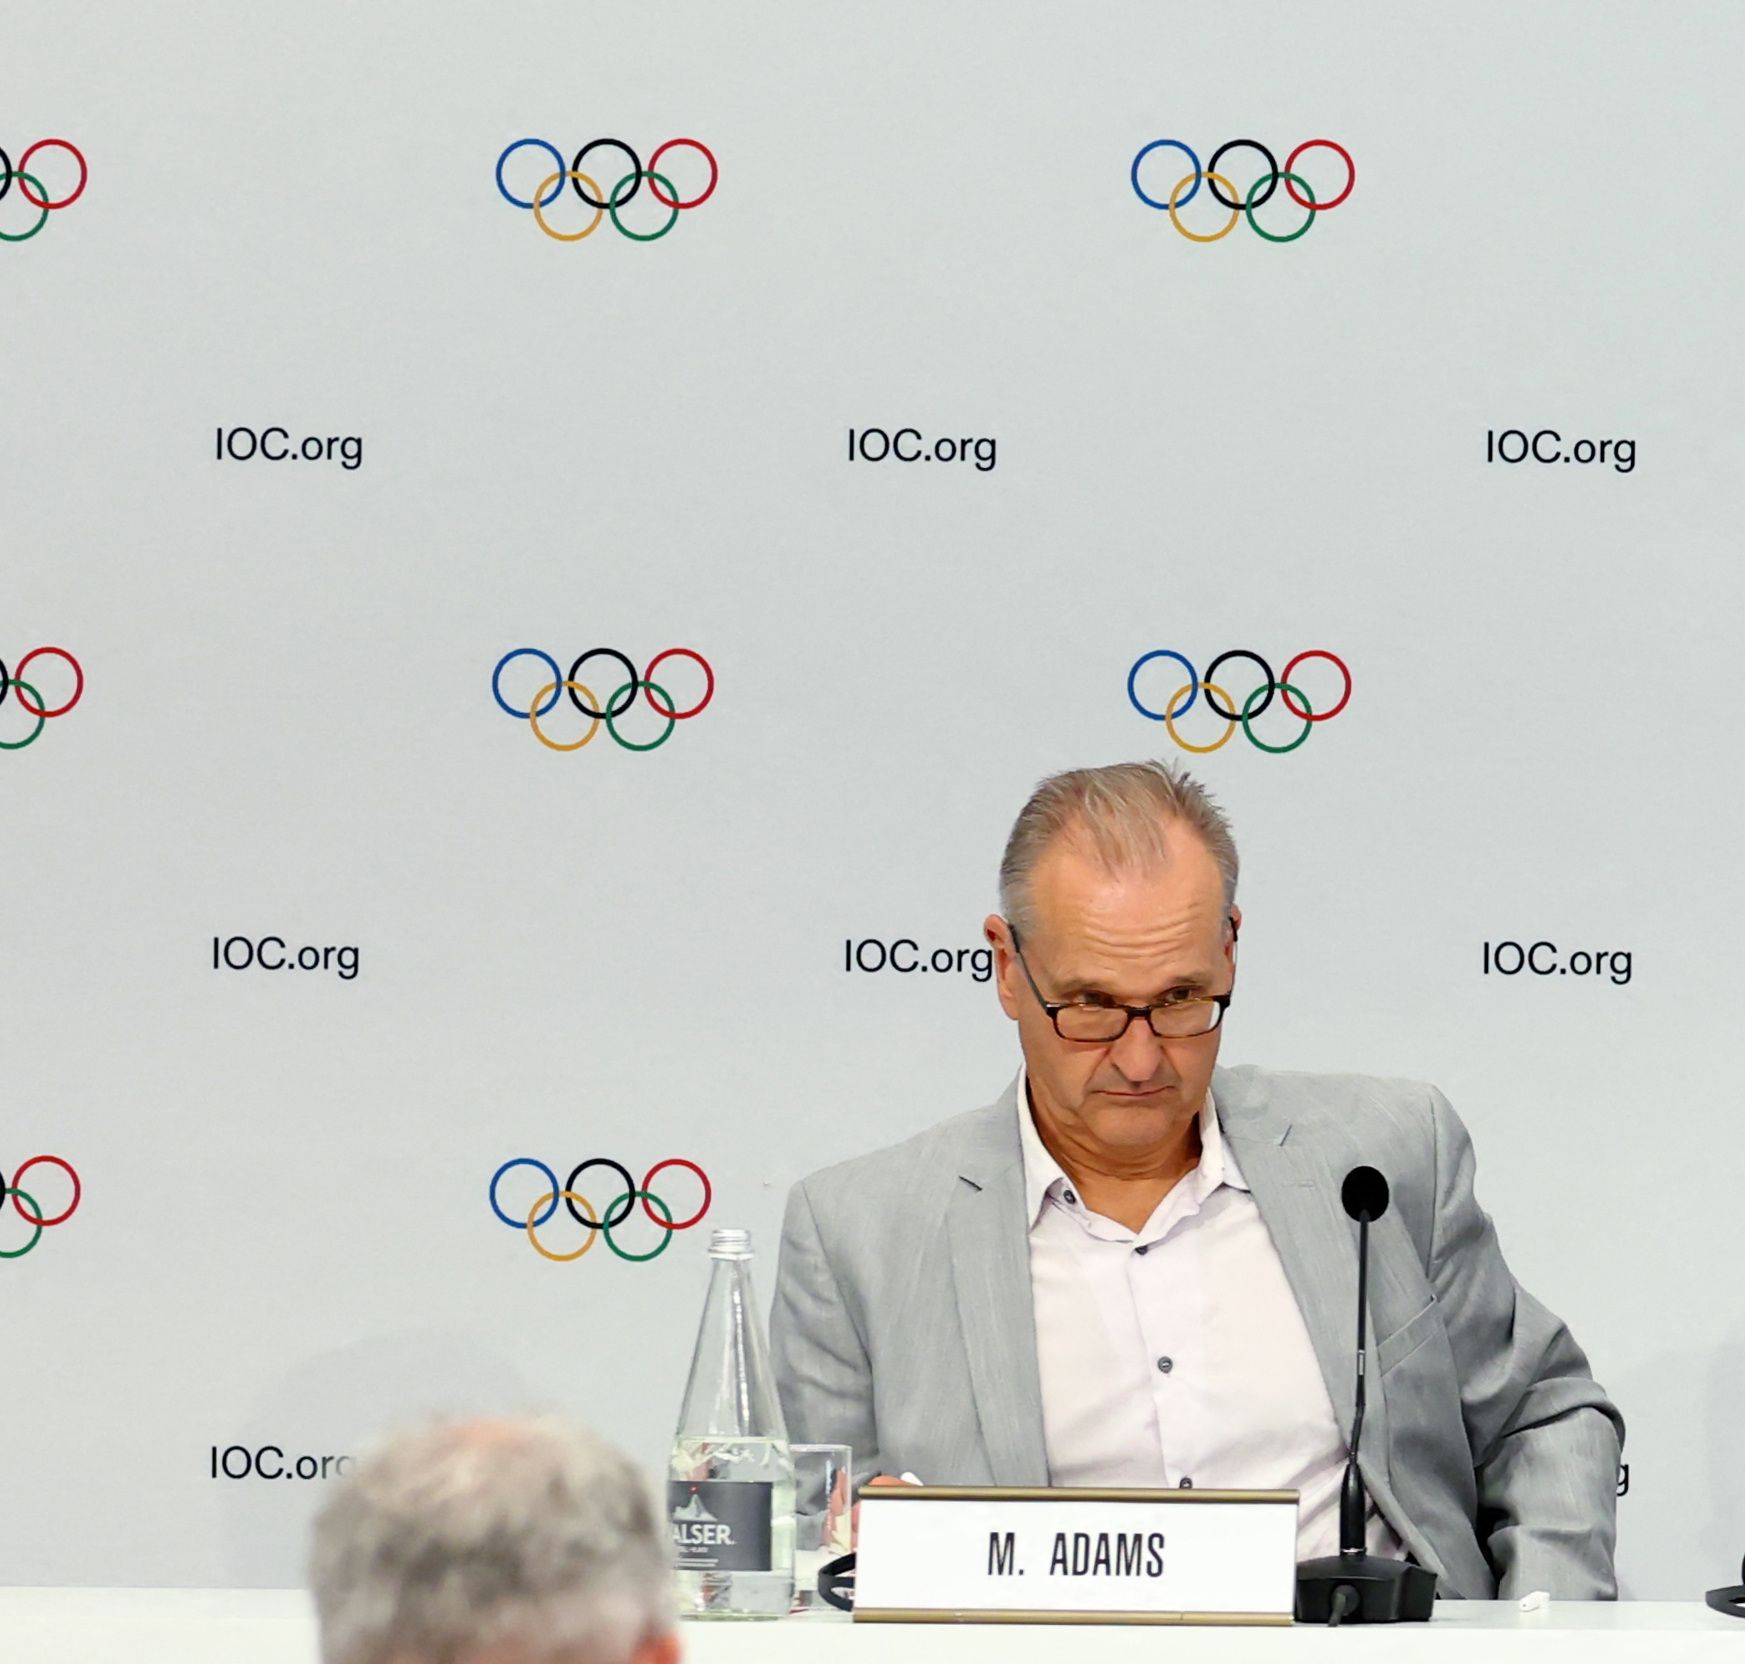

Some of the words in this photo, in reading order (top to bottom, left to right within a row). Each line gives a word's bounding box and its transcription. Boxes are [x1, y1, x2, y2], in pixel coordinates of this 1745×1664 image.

[216, 426, 362, 470] IOC.org
[848, 427, 996, 471] IOC.org
[1487, 429, 1635, 473] IOC.org
[213, 935, 360, 980] IOC.org
[845, 938, 993, 982] IOC.org
[1483, 941, 1632, 985] IOC.org
[672, 1523, 733, 1546] ALSER
[988, 1531, 1024, 1576] M.
[1049, 1532, 1165, 1578] ADAMS
